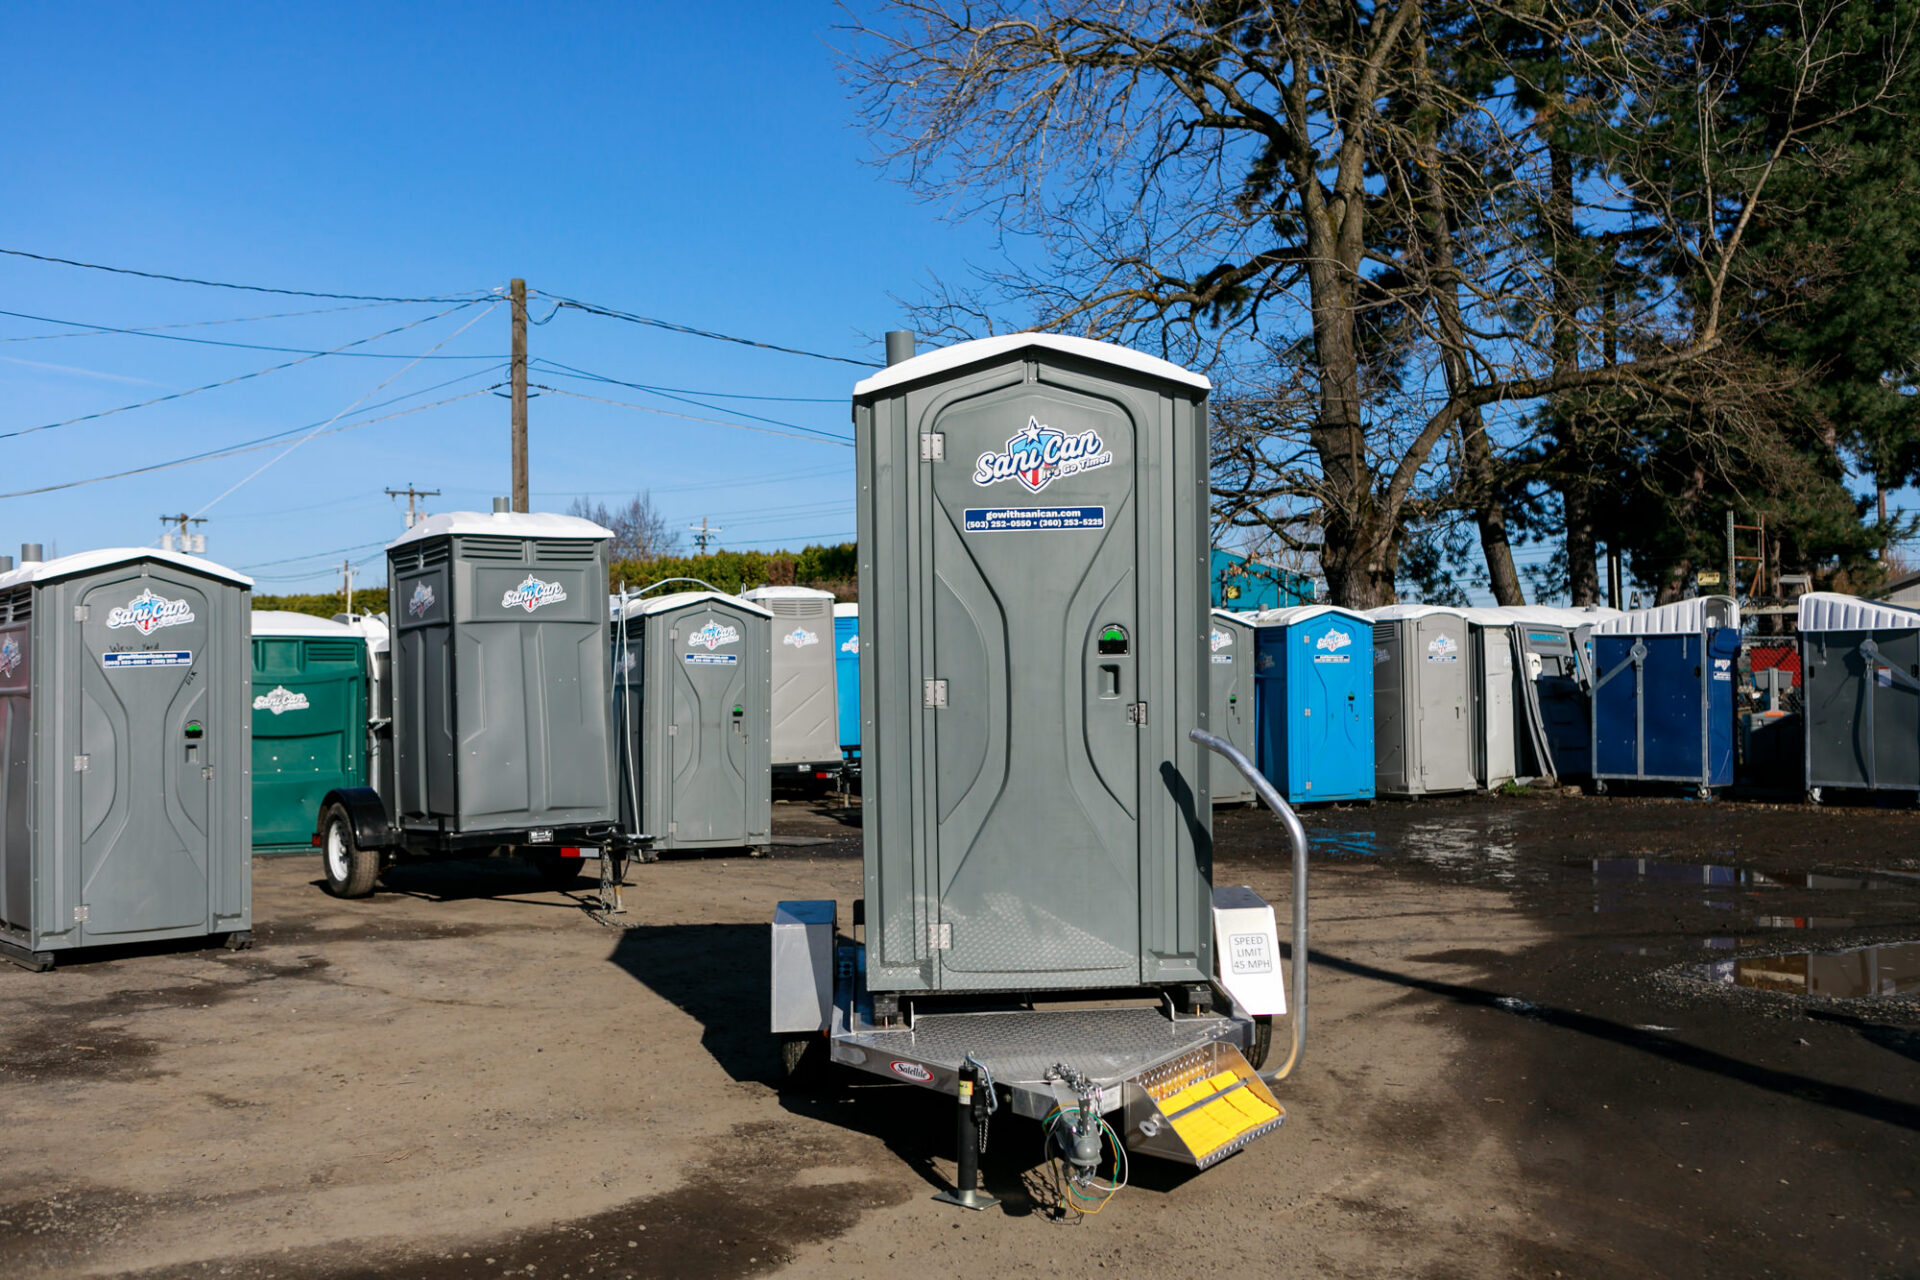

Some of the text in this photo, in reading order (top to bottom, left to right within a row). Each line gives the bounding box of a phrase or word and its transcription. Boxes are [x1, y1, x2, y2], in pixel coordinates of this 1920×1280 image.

[974, 431, 1101, 484] Sani Can
[1063, 464, 1078, 475] Go
[1079, 454, 1110, 470] Time!
[986, 509, 1081, 521] gowithsanican.com
[966, 520, 989, 529] (503)
[1039, 518, 1062, 528] (360)
[503, 590, 534, 607] Sani
[535, 583, 561, 598] Can
[109, 607, 151, 627] Sani
[152, 601, 187, 618] Can
[1234, 936, 1264, 945] SPEED
[1237, 948, 1263, 957] LIMIT
[1234, 959, 1271, 969] 45 MPH
[897, 1063, 928, 1079] Satellite
